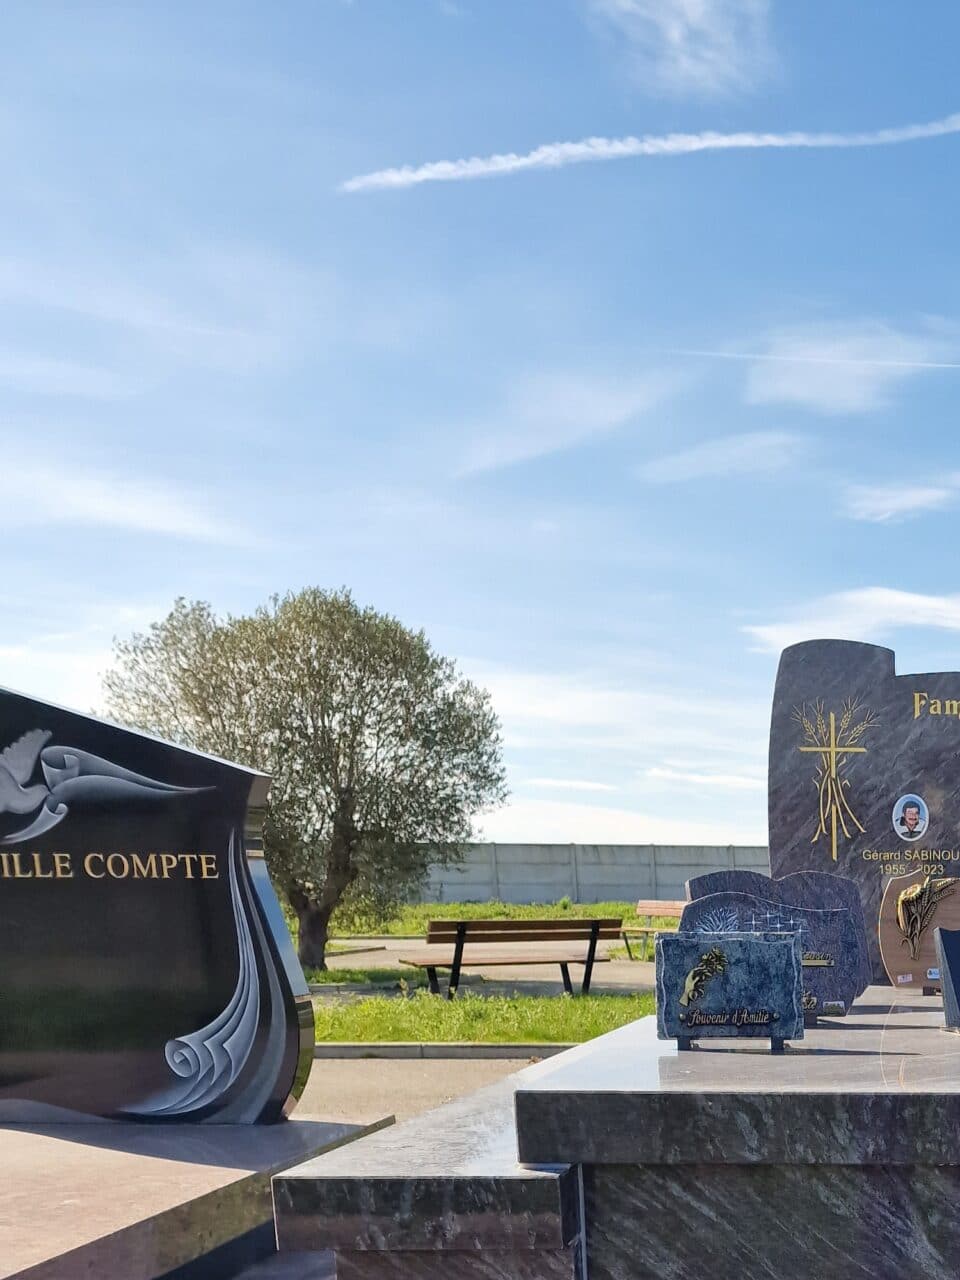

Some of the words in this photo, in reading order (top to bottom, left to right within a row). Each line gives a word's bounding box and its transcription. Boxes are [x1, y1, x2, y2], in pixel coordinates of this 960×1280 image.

[862, 848, 901, 861] Gérard
[904, 849, 960, 861] SABINOU
[84, 853, 220, 879] COMPTE
[879, 864, 906, 875] 1955
[687, 1008, 729, 1027] Souvenir
